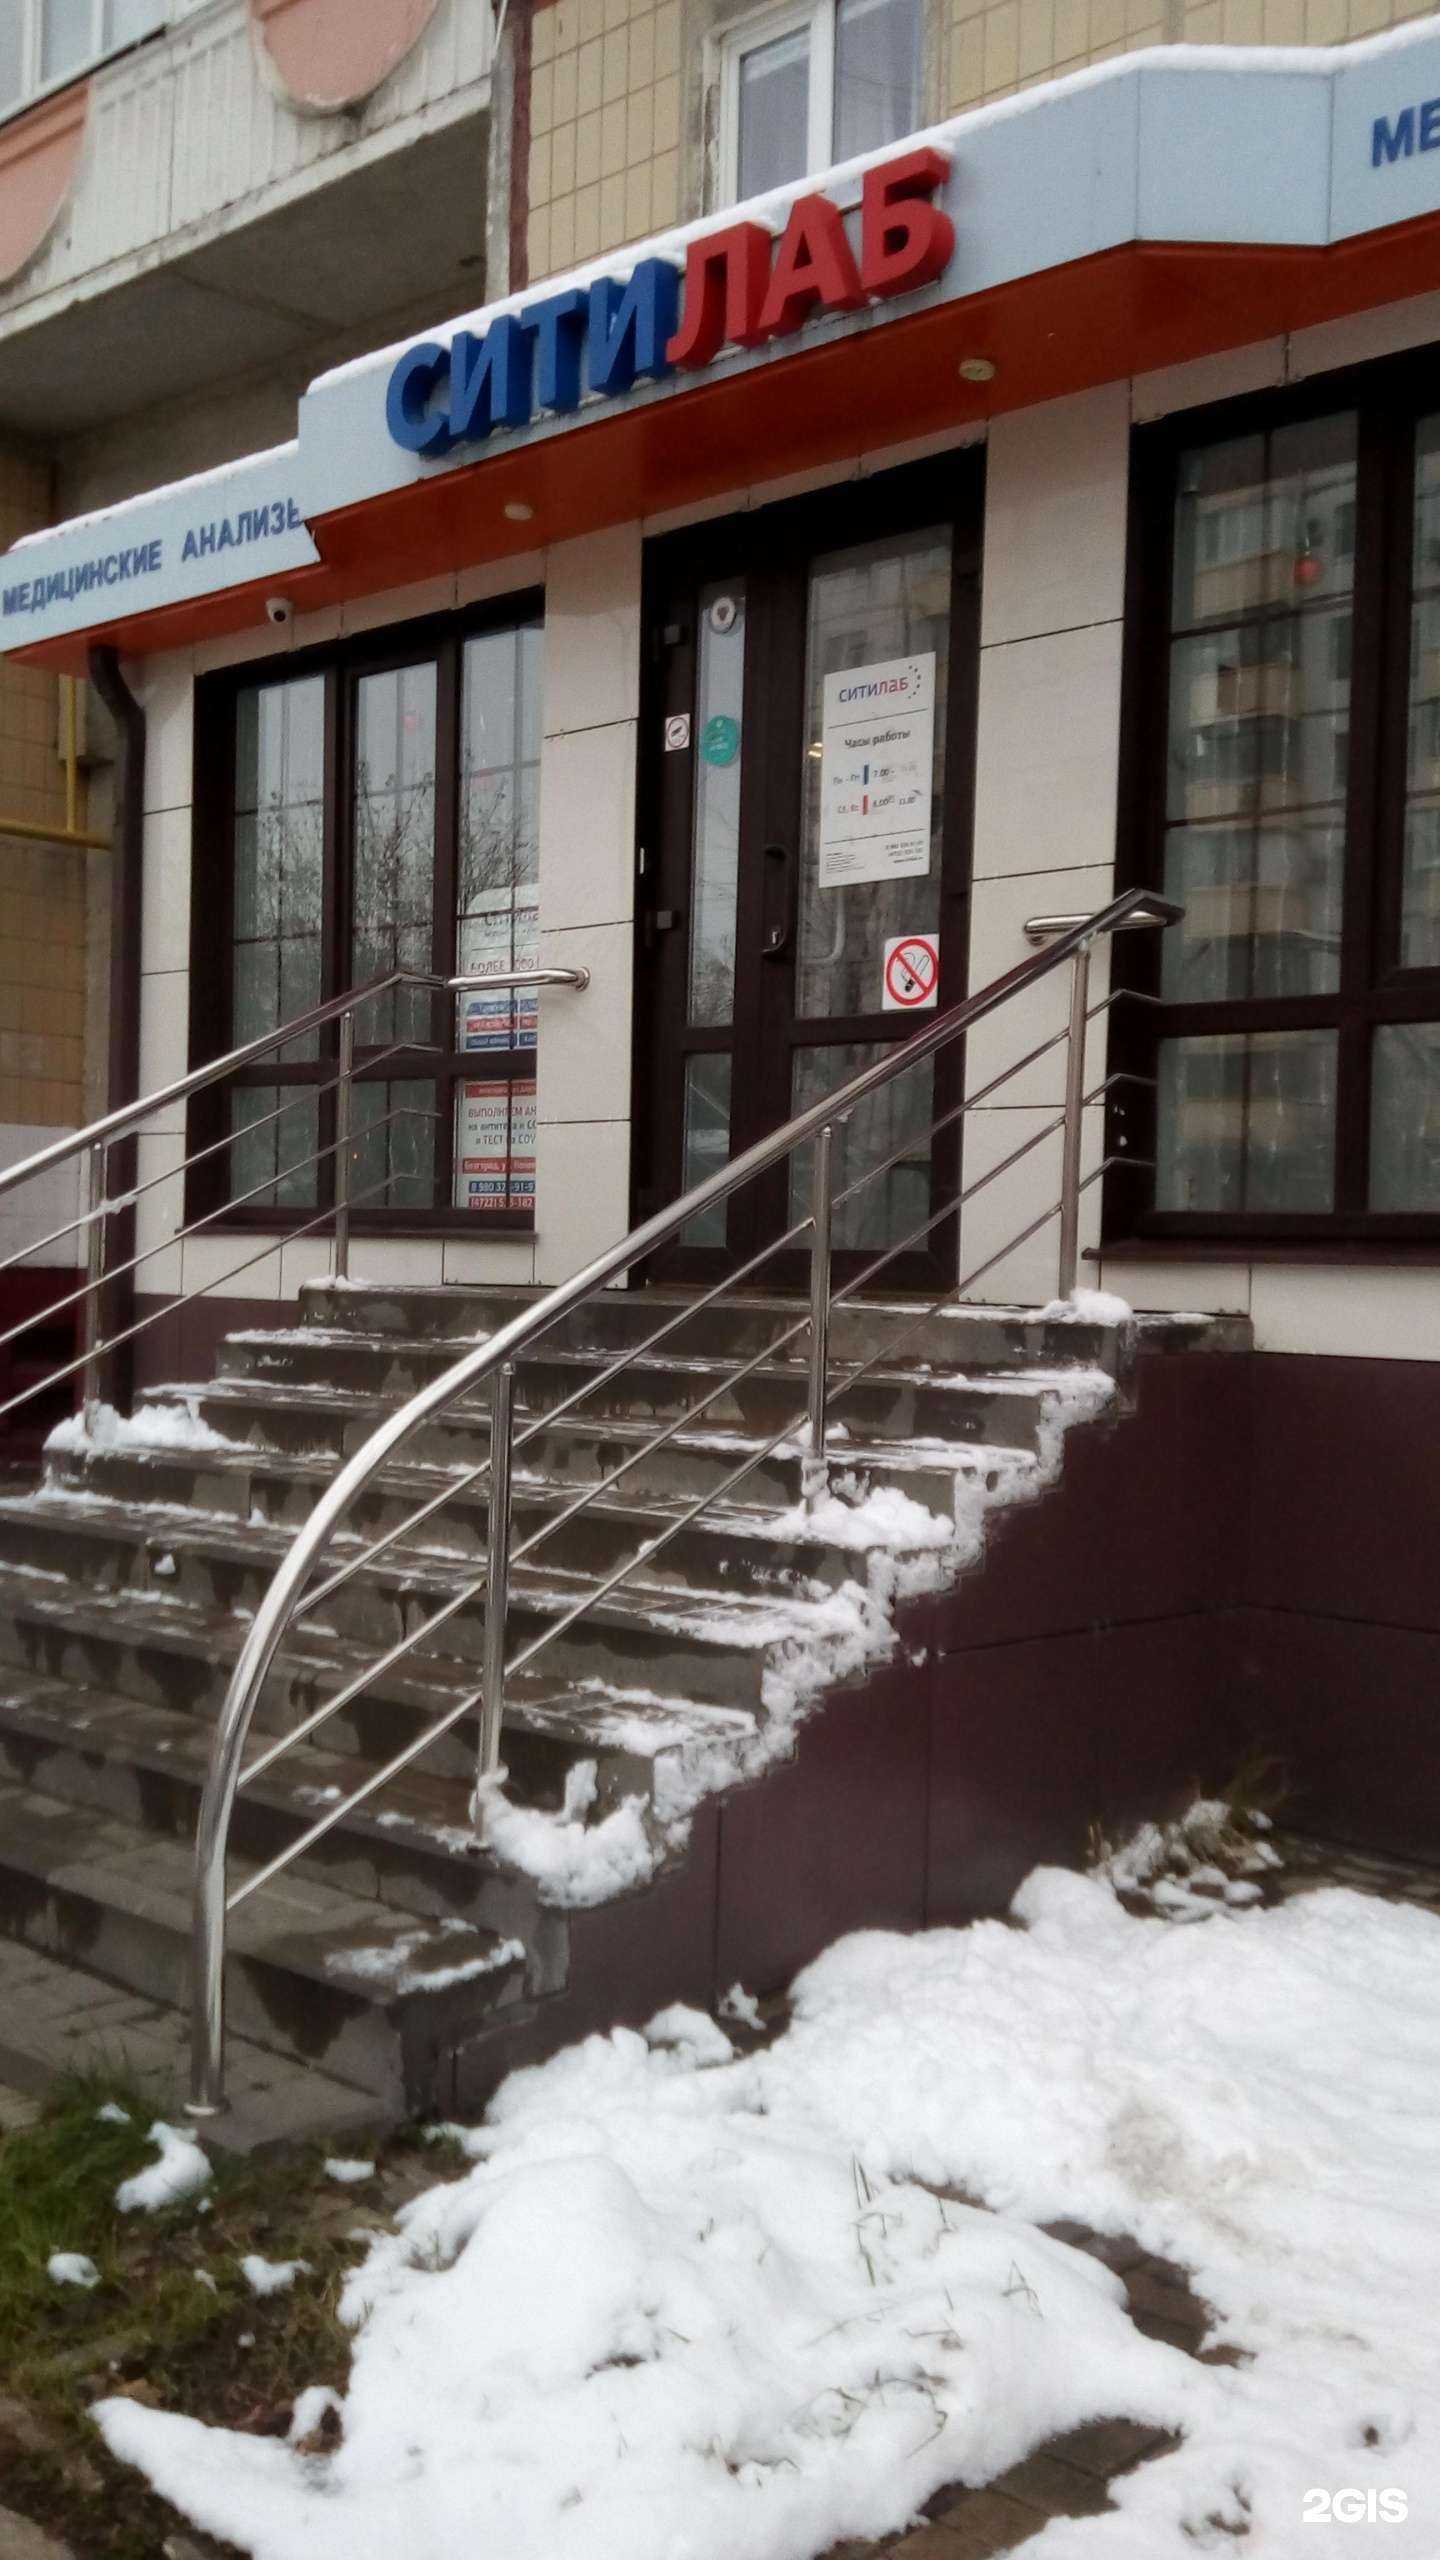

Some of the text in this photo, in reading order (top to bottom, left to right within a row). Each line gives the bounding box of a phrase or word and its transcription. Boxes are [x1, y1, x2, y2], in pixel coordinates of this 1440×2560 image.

[1372, 97, 1440, 168] МЕ
[386, 146, 955, 456] СИТИЛАБ
[2, 539, 162, 616] МЕДИЦИНСКИЕ
[845, 730, 911, 748] Часы работы
